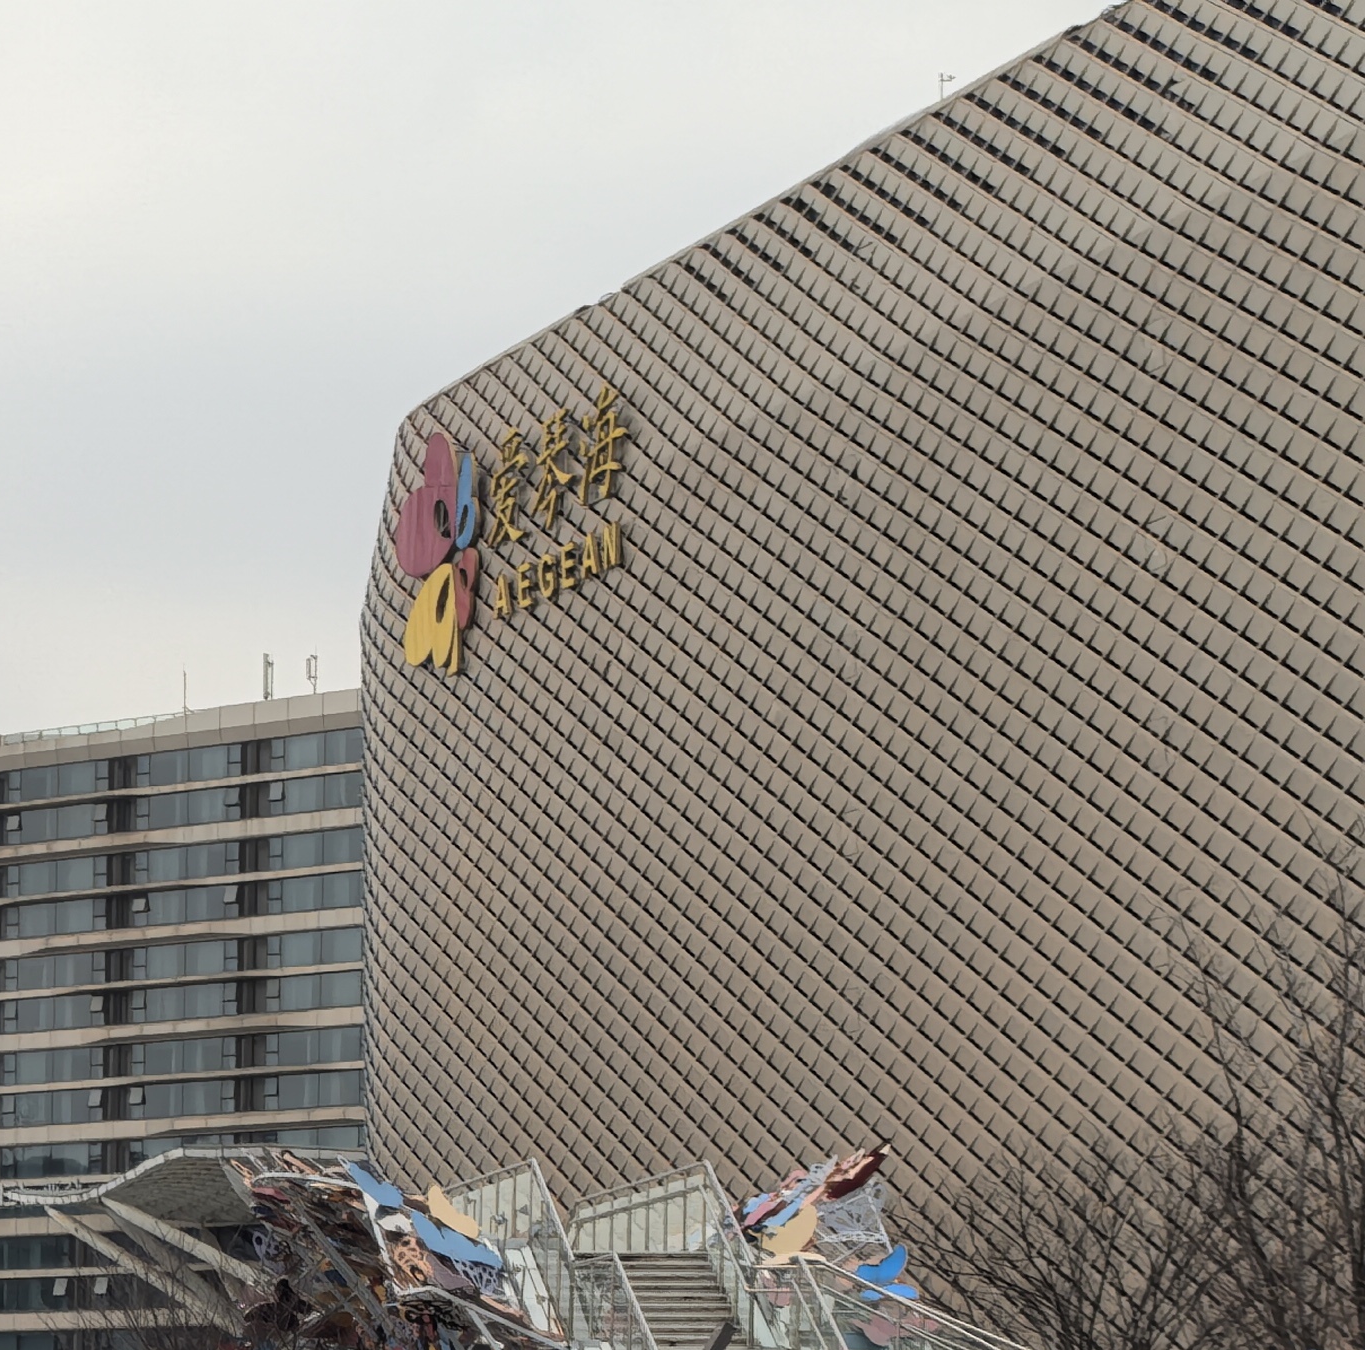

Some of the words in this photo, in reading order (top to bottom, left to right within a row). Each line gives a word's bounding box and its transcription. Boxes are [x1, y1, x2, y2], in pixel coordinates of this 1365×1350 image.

[488, 382, 628, 547] 爱琴海
[492, 521, 622, 619] AEGEAN
